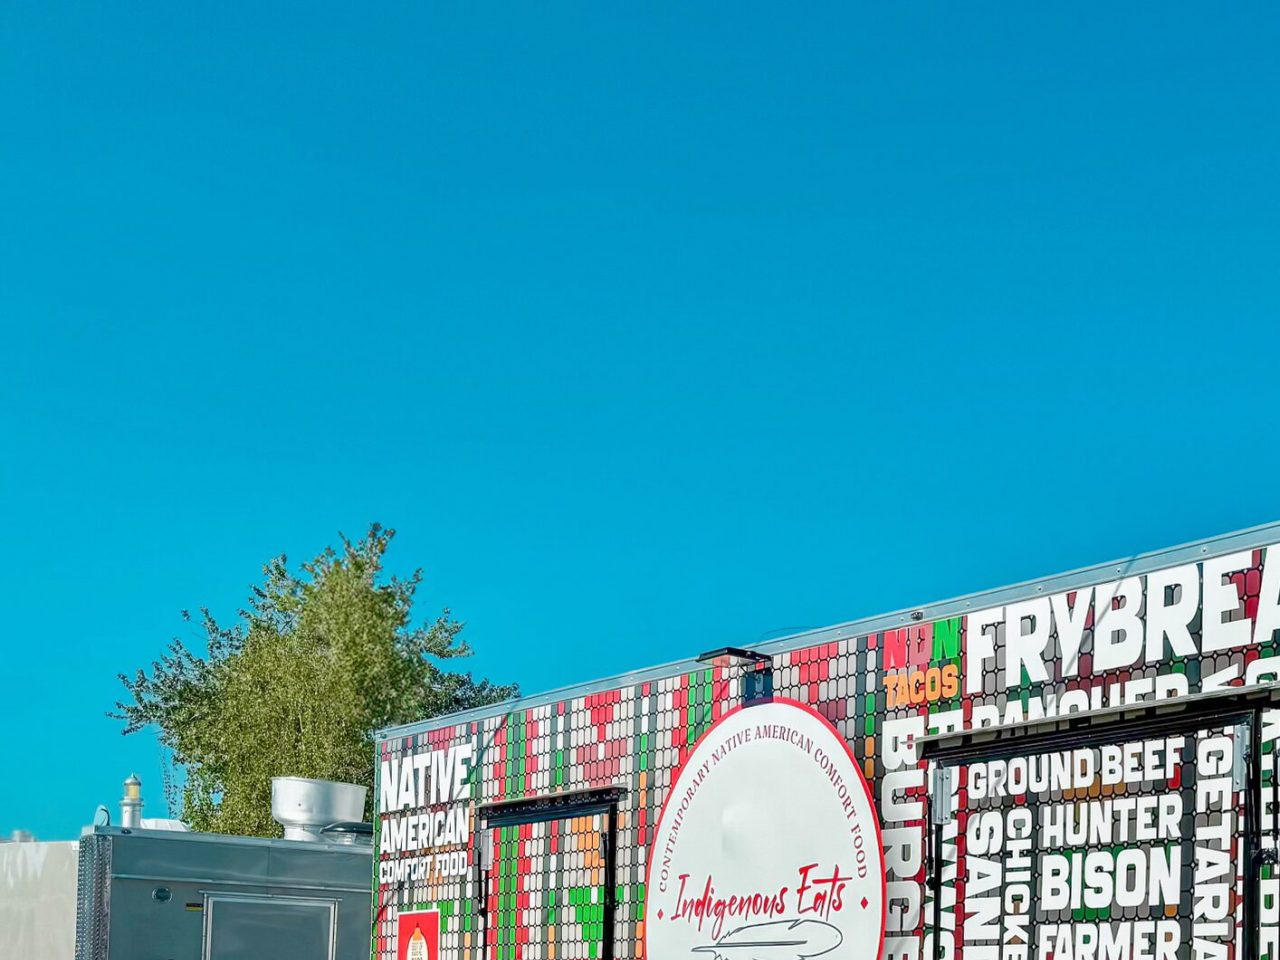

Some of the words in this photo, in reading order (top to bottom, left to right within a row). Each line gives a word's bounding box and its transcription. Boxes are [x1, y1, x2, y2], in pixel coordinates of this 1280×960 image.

[882, 618, 963, 672] NDN
[882, 663, 959, 709] TACOS
[379, 743, 473, 813] NATIVE
[967, 747, 1095, 800] GROUND
[1100, 736, 1185, 786] BEEF
[379, 806, 471, 856] AMERICAN
[658, 760, 712, 893] CONTEMPORARY
[711, 727, 752, 767] NATIVE
[754, 724, 814, 755] AMERICAN
[813, 748, 858, 821] COMFORT
[850, 822, 868, 879] FOOD
[1041, 793, 1182, 849] HUNTER
[378, 854, 433, 885] COMFORT
[434, 850, 469, 879] FOOD
[1040, 845, 1182, 911] BISON
[670, 873, 789, 941] Indigenous
[796, 862, 853, 922] Eats
